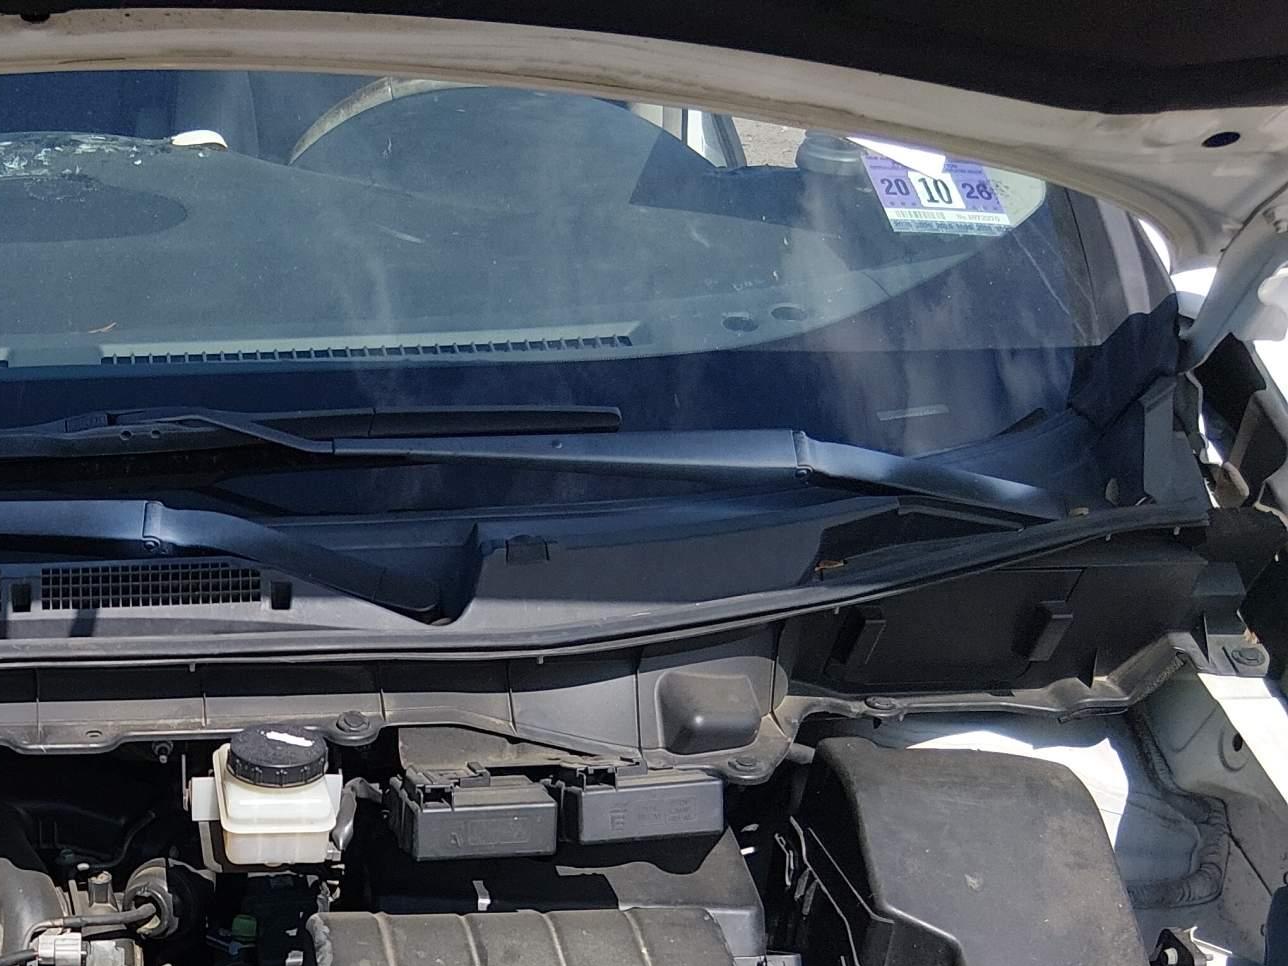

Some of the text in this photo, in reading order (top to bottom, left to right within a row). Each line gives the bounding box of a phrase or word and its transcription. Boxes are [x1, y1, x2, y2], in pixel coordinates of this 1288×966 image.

[880, 177, 993, 205] 20 10 26
